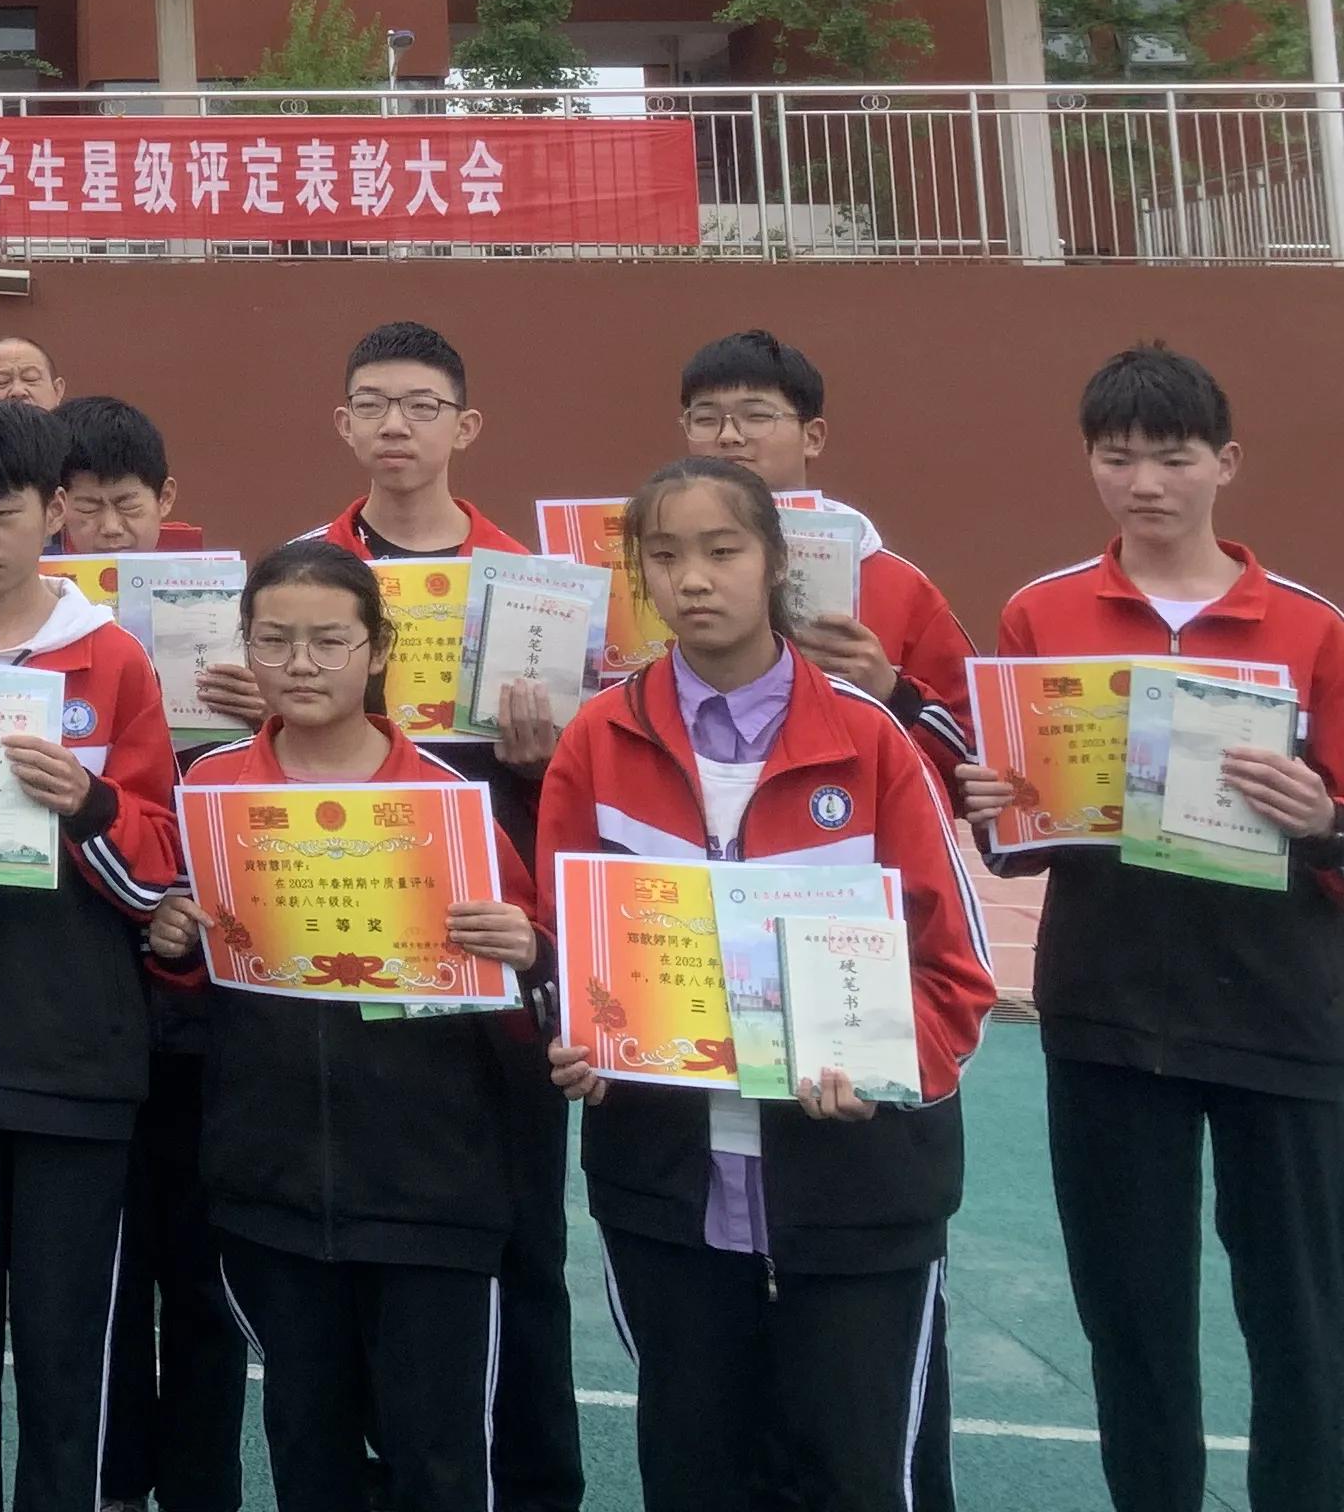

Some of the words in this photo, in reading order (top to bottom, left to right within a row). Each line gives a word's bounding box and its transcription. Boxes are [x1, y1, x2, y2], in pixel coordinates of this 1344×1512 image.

[523, 624, 543, 679] 硬笔书法
[305, 918, 383, 933] 三等奖
[839, 959, 862, 1027] 硬笔书法
